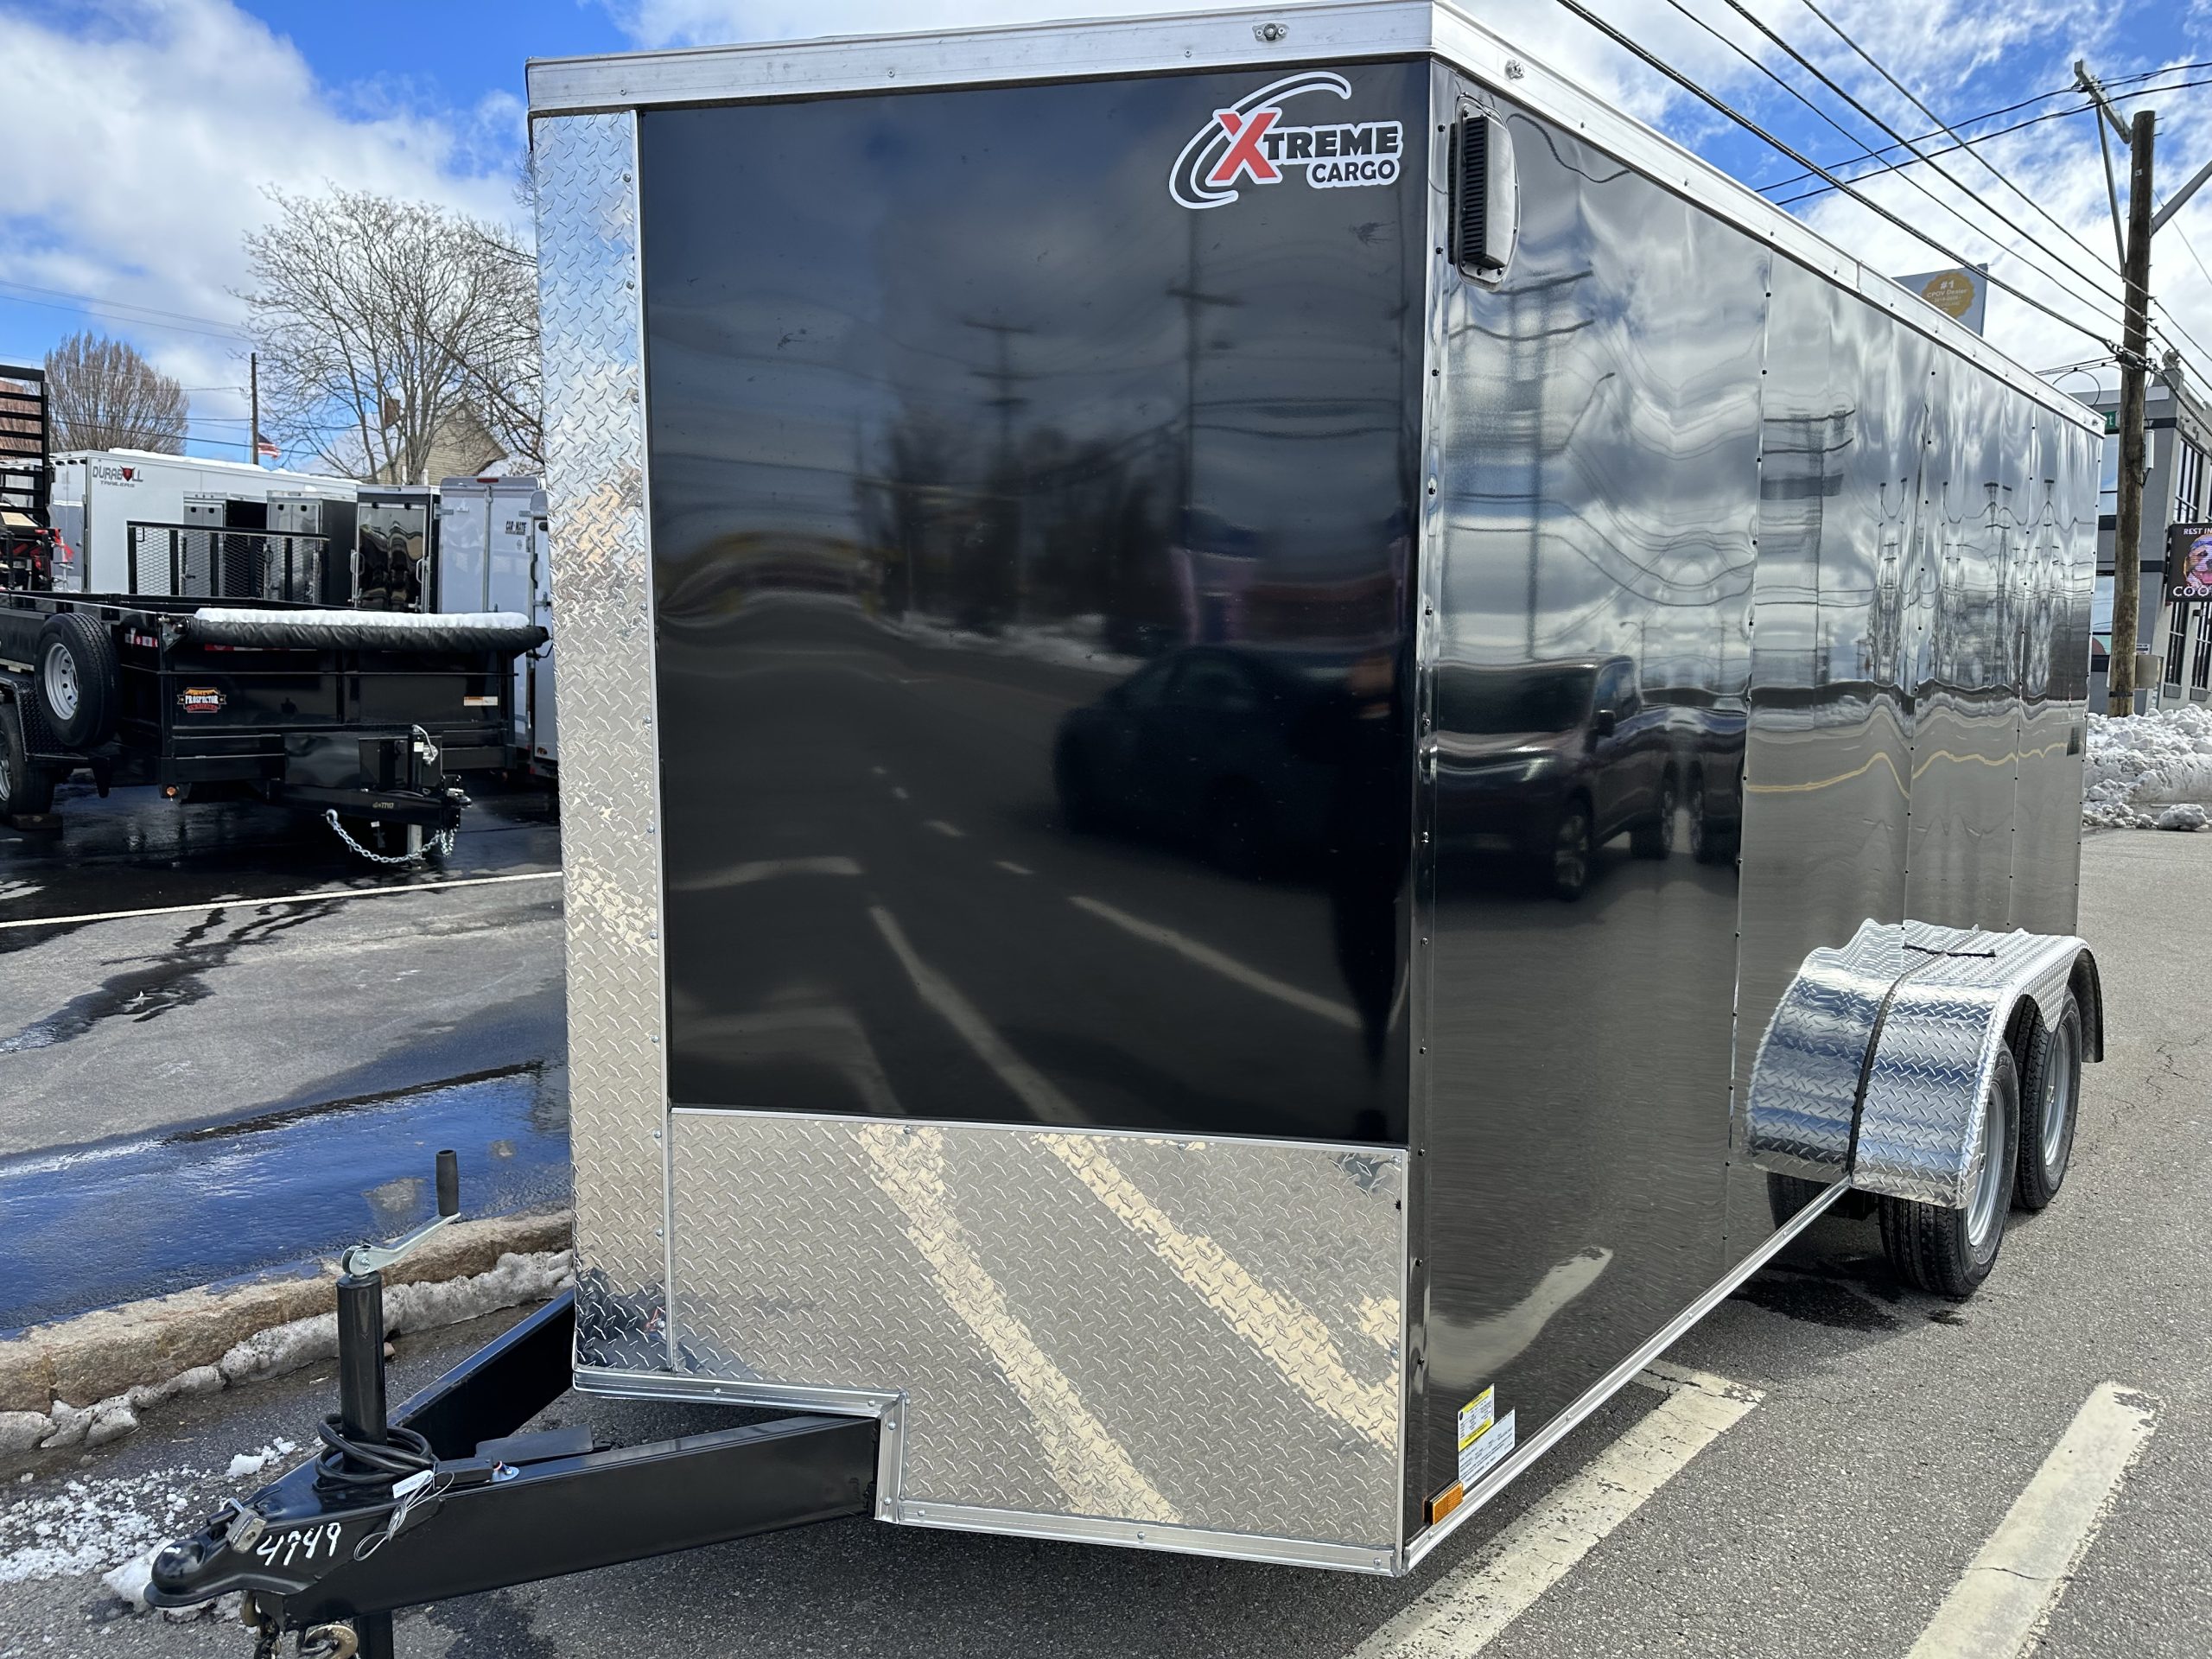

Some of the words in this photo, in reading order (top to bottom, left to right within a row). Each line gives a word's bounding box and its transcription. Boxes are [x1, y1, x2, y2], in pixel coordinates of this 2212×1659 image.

[1211, 111, 1399, 181] XTREME
[1312, 159, 1395, 183] CARGO
[1941, 280, 1955, 290] #1
[2172, 586, 2212, 597] COO
[185, 695, 219, 705] PROSPECTOR
